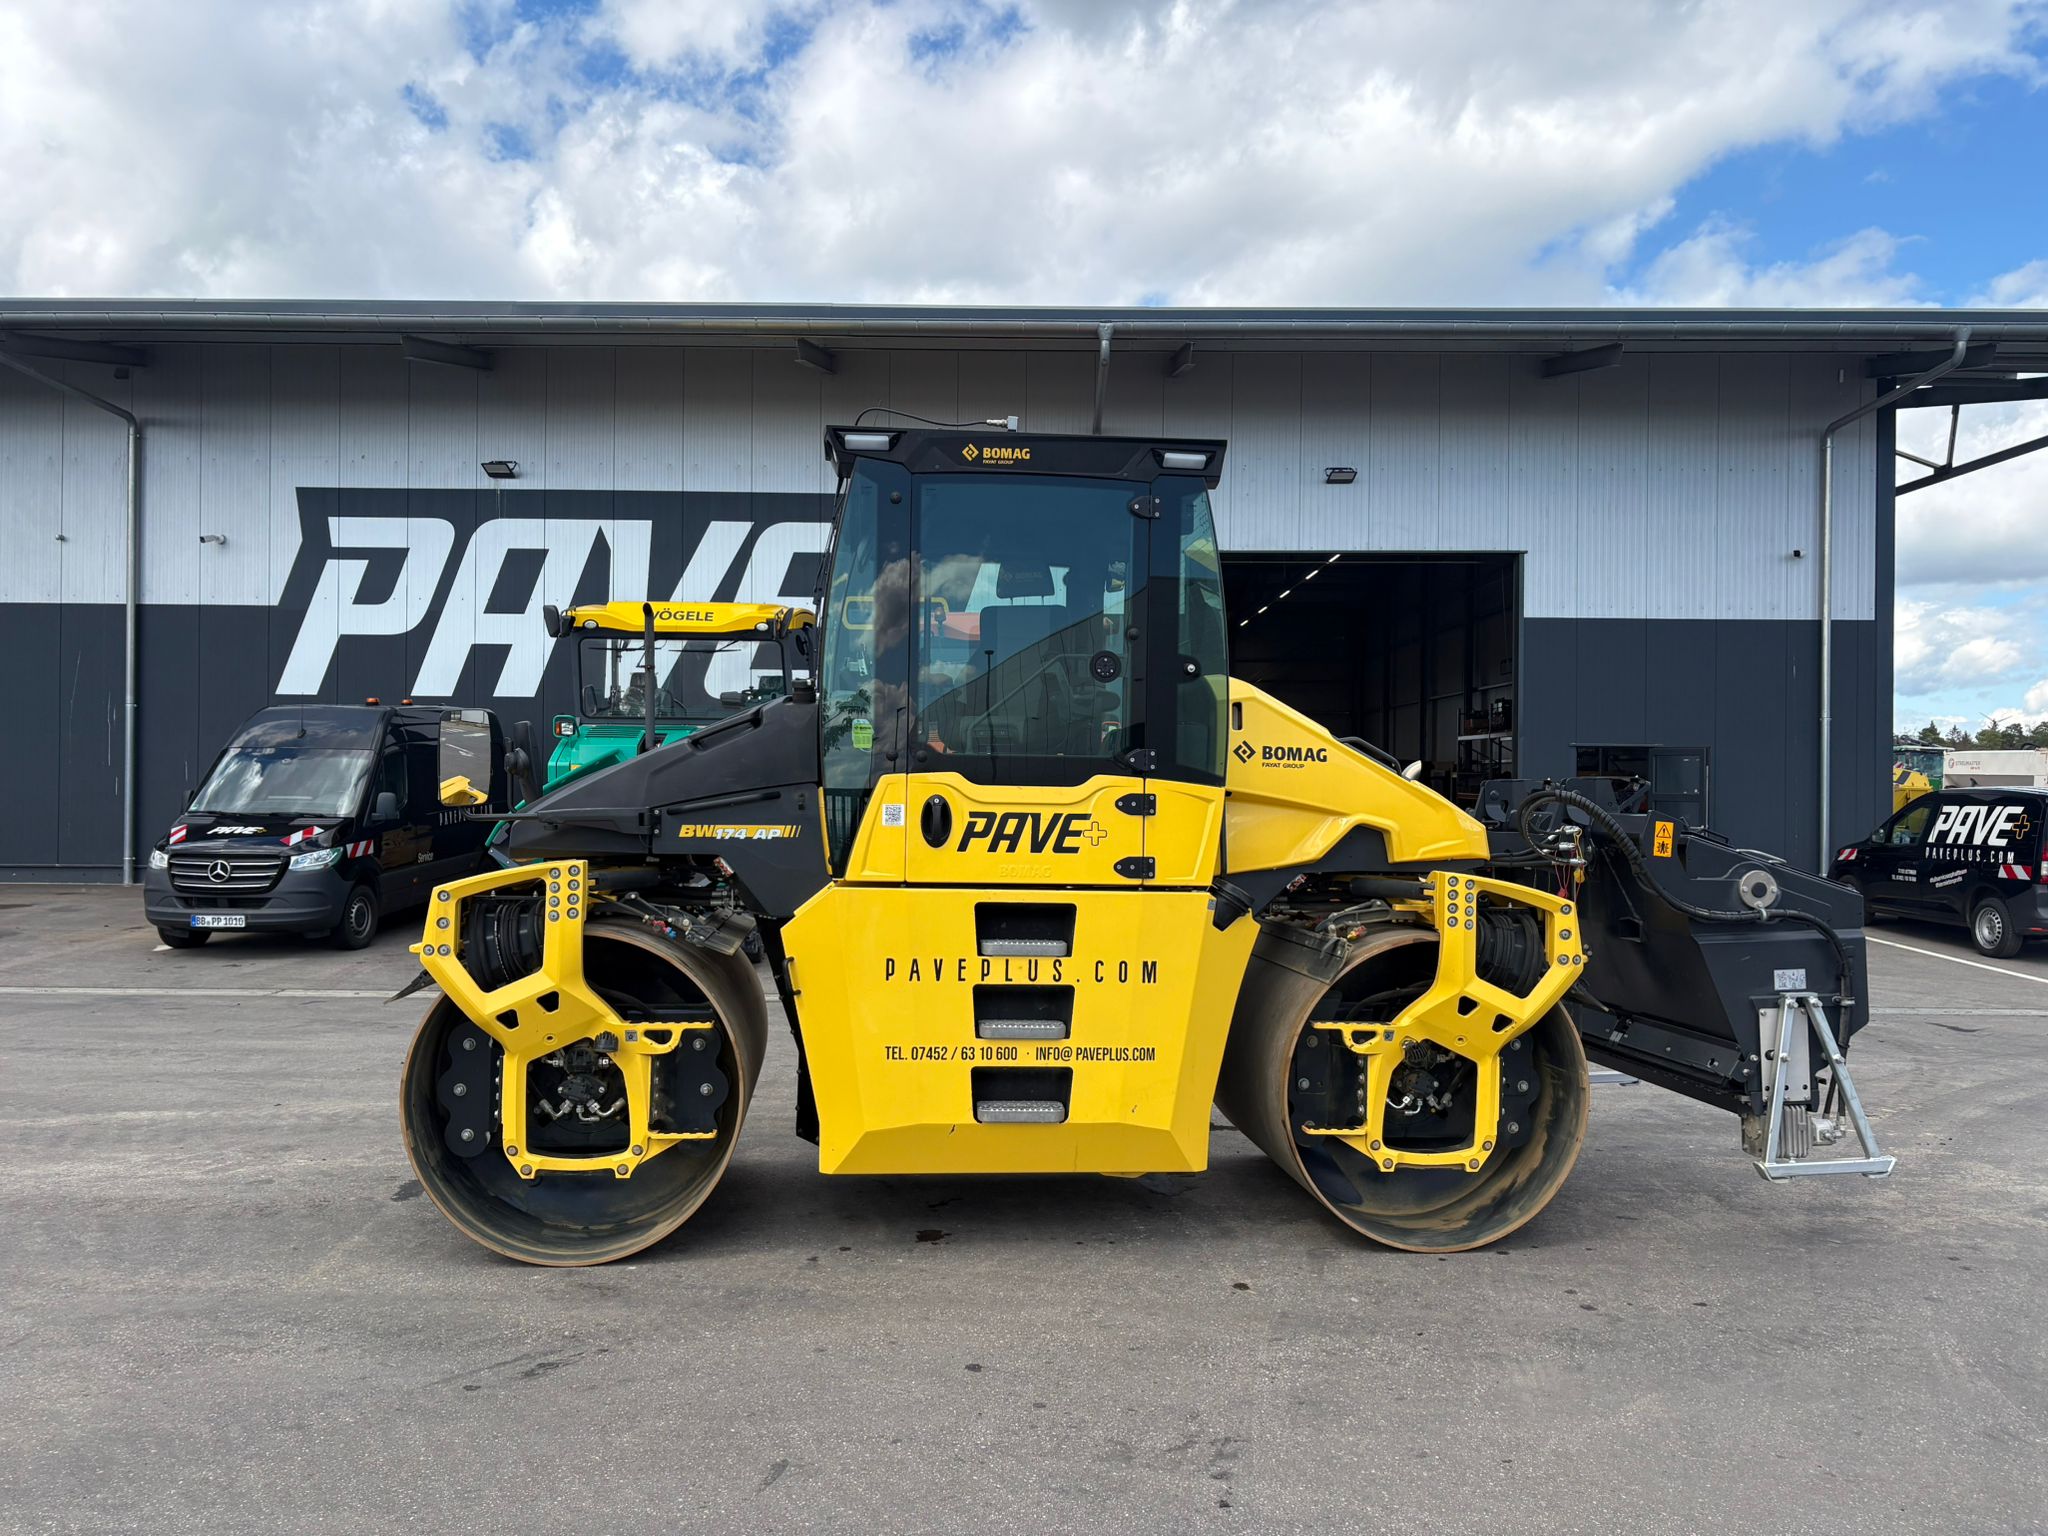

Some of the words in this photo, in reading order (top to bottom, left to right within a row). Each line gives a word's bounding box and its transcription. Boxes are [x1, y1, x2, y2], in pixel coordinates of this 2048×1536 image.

[982, 447, 1031, 460] BOMAG
[1262, 745, 1328, 763] BOMAG
[752, 828, 782, 840] AP
[417, 851, 434, 864] Service
[1925, 846, 2016, 864] PAVEPLUS.COM
[196, 916, 206, 926] BB
[211, 916, 222, 926] PP
[223, 916, 244, 926] 1010
[884, 957, 1158, 984] PAVEPLUS.COM
[885, 1046, 908, 1061] TEL.
[911, 1046, 948, 1061] 07452
[961, 1046, 976, 1061] 63
[979, 1046, 993, 1061] 10
[995, 1046, 1018, 1061] 600
